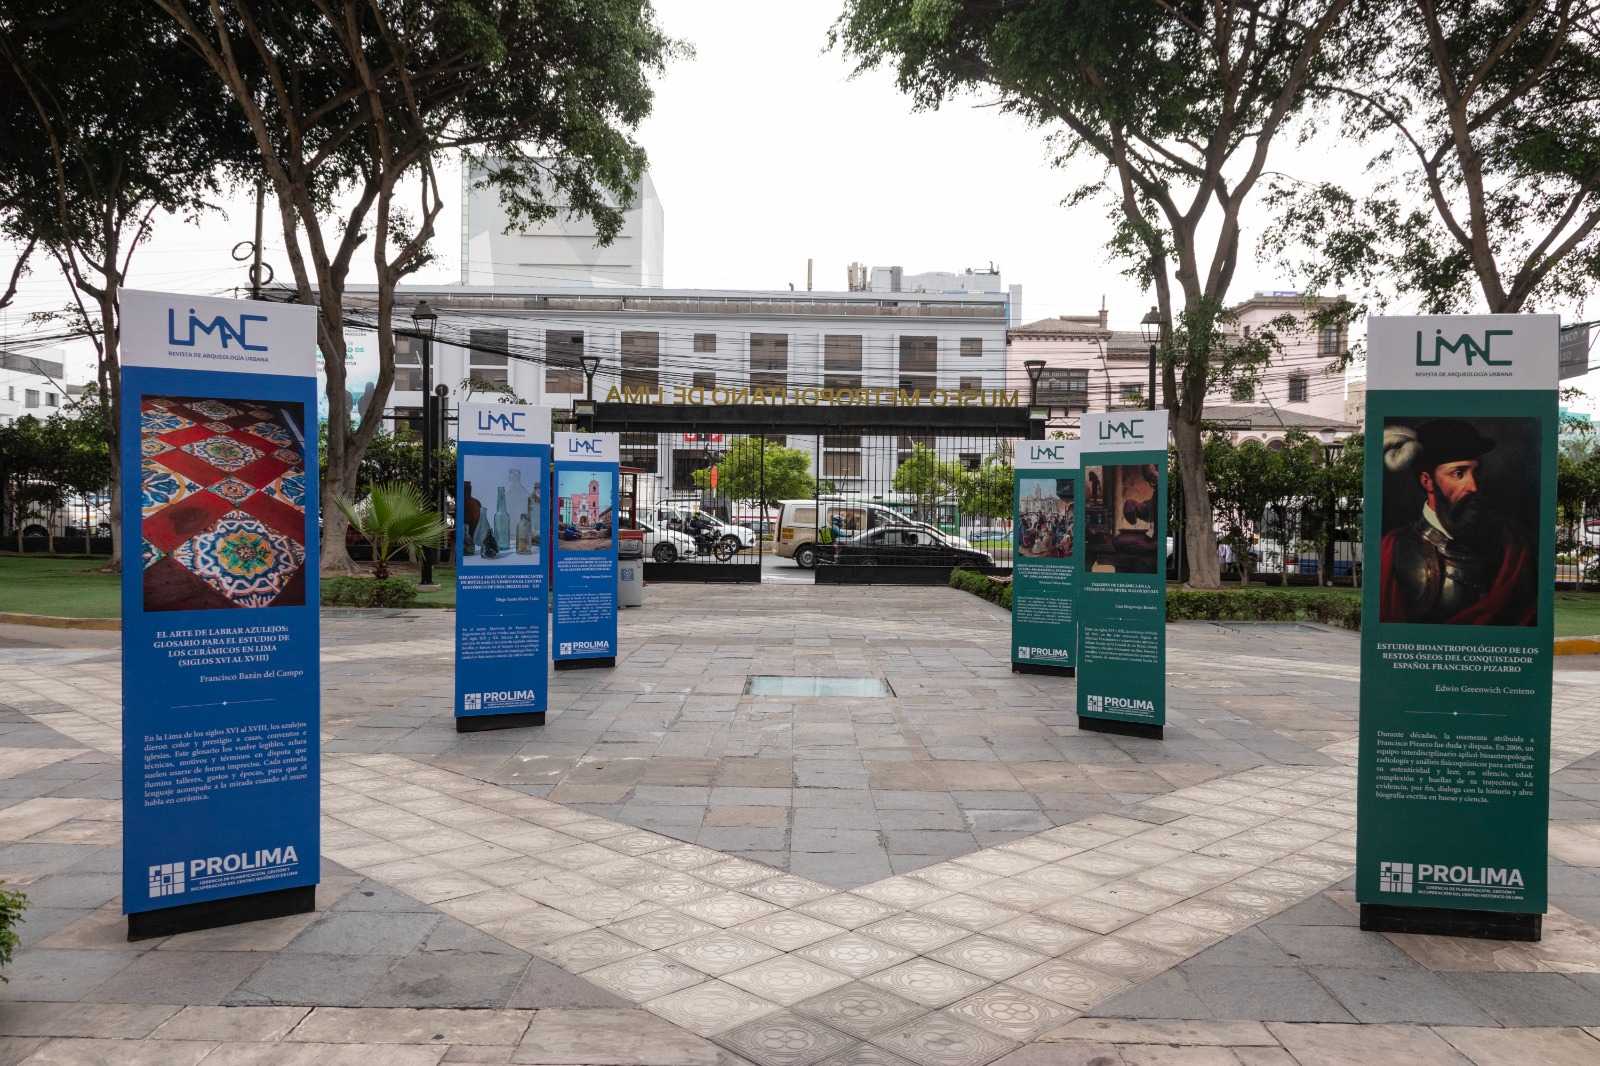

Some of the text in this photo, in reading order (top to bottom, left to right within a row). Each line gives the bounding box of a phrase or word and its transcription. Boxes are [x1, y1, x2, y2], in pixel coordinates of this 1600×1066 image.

[203, 352, 244, 361] ARQUEOLOGÍA
[209, 628, 243, 636] LABRAR
[245, 626, 288, 634] AZULEJOS:
[154, 639, 200, 648] GLOSARIO
[238, 635, 276, 644] ESTUDIO
[573, 641, 609, 649] PROLIMA
[187, 644, 240, 656] CERÁMICOS
[1031, 648, 1068, 656] PROLIMA
[1416, 643, 1507, 653] BIOANTROPOLÓGICO
[178, 658, 214, 667] (SIGLOS
[245, 654, 269, 664] XVIII)
[1416, 652, 1443, 661] ÓSEOS
[1463, 655, 1532, 664] CONQUISTADOR
[1393, 661, 1429, 670] ESPAÑOL
[200, 673, 237, 682] Francisco
[239, 671, 262, 679] Bazán
[276, 668, 304, 679] Campo
[483, 690, 534, 701] PROLIMA
[1104, 697, 1154, 710] PROLIMA
[205, 728, 224, 738] siglos
[248, 724, 268, 733] XVIII,
[281, 721, 307, 731] azulejos
[144, 743, 168, 751] dieron
[202, 737, 232, 748] prestigio
[267, 731, 300, 739] conventos
[1410, 732, 1438, 740] décadas,
[144, 752, 171, 762] iglesias.
[192, 747, 220, 758] glosario
[235, 743, 256, 751] vuelve
[259, 740, 285, 751] legibles,
[288, 738, 307, 746] aclara
[1468, 743, 1493, 752] disputa.
[144, 760, 174, 771] técnicas,
[179, 757, 207, 766] motivos
[220, 752, 250, 762] términos
[267, 748, 291, 759] disputa
[1376, 749, 1533, 762] equipo interdisciplinario aplicó bioantropología,
[144, 770, 167, 779] suelen
[204, 764, 225, 772] forma
[227, 760, 261, 772] imprecisa.
[263, 758, 281, 766] Cada
[282, 755, 307, 764] entrada
[1376, 757, 1409, 766] radiología
[1440, 759, 1488, 769] fisicoquímicos
[190, 846, 298, 877] PROLIMA
[1418, 864, 1524, 886] PROLIMA
